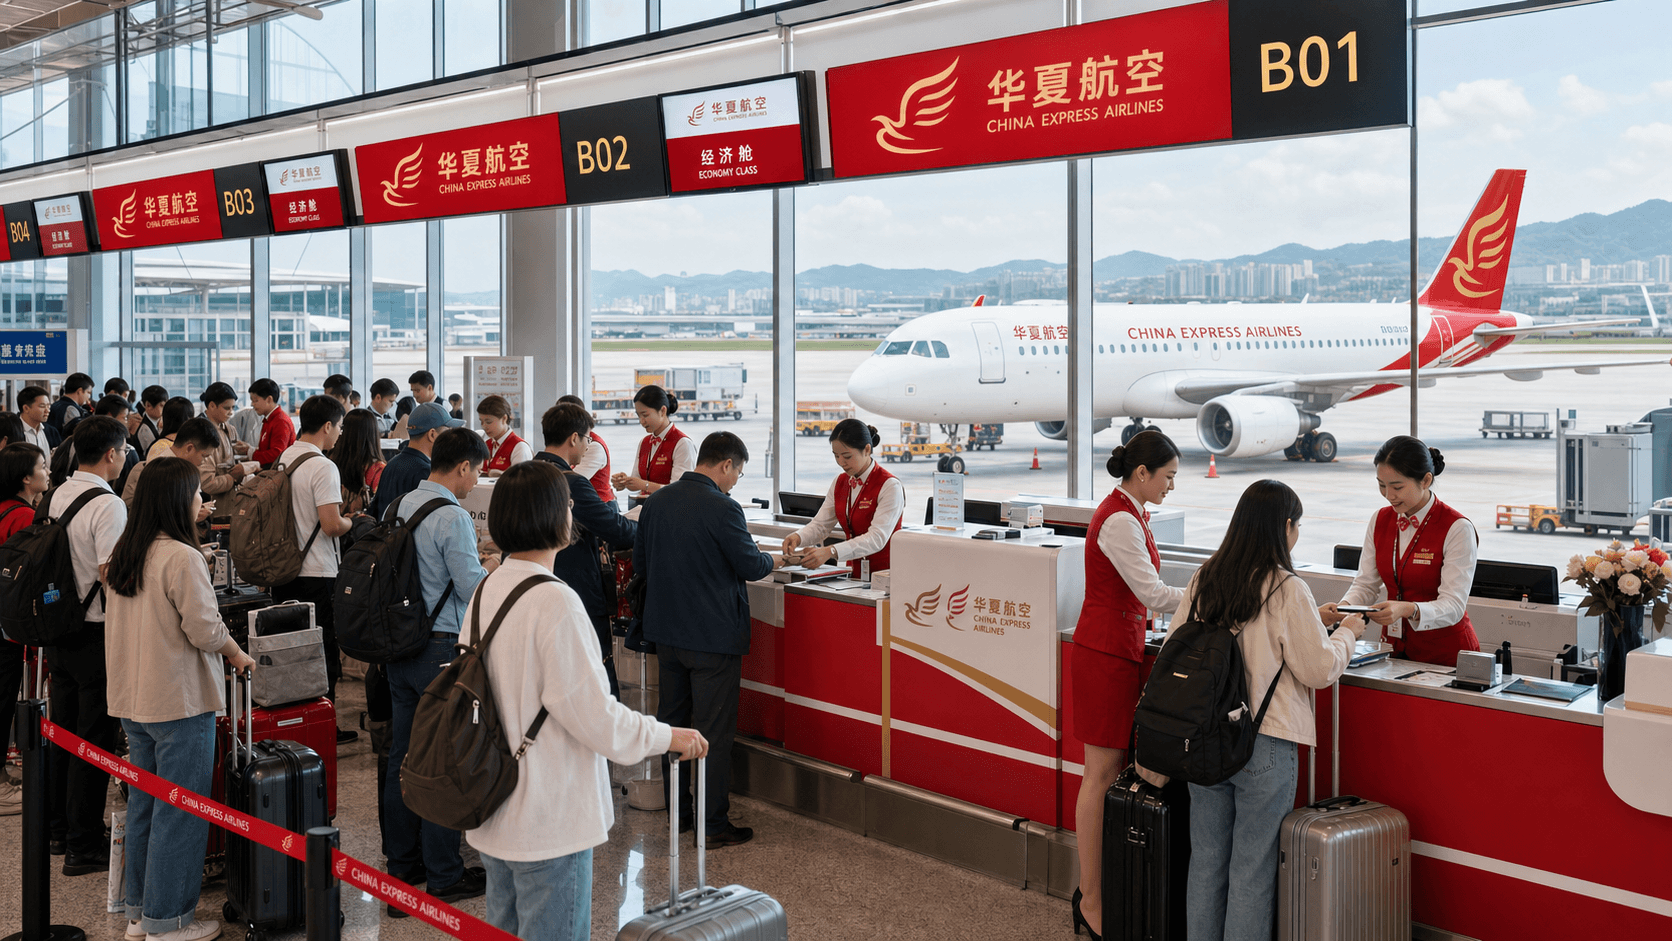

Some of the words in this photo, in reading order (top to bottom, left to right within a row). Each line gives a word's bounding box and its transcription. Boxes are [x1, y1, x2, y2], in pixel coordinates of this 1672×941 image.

[1260, 30, 1360, 93] B01
[987, 47, 1165, 113] 华夏航空
[711, 96, 767, 116] 华夏航空
[987, 116, 1034, 133] CHINA
[1041, 107, 1099, 127] EXPRESS
[1104, 98, 1164, 118] AIRLINES
[437, 141, 531, 181] 华夏航空
[576, 135, 631, 174] B02
[701, 144, 753, 166] 经济舱
[438, 184, 464, 194] CHINA
[467, 179, 496, 191] EXPRESS
[499, 174, 531, 187] AIRLINES
[698, 168, 734, 180] ECONOMY
[735, 165, 758, 176] CLASS
[144, 190, 199, 219] 华夏航空
[223, 188, 255, 217] B03
[10, 220, 30, 243] B04
[1013, 324, 1068, 340] 华夏航空
[1127, 327, 1176, 340] CHINA
[1180, 326, 1242, 339] EXPRESS
[1246, 325, 1302, 338] AIRLINES
[973, 596, 1031, 618] 华夏航空
[349, 867, 378, 890] CHINA
[380, 882, 418, 910] EXPRESS
[419, 902, 461, 932] AIRLINES
